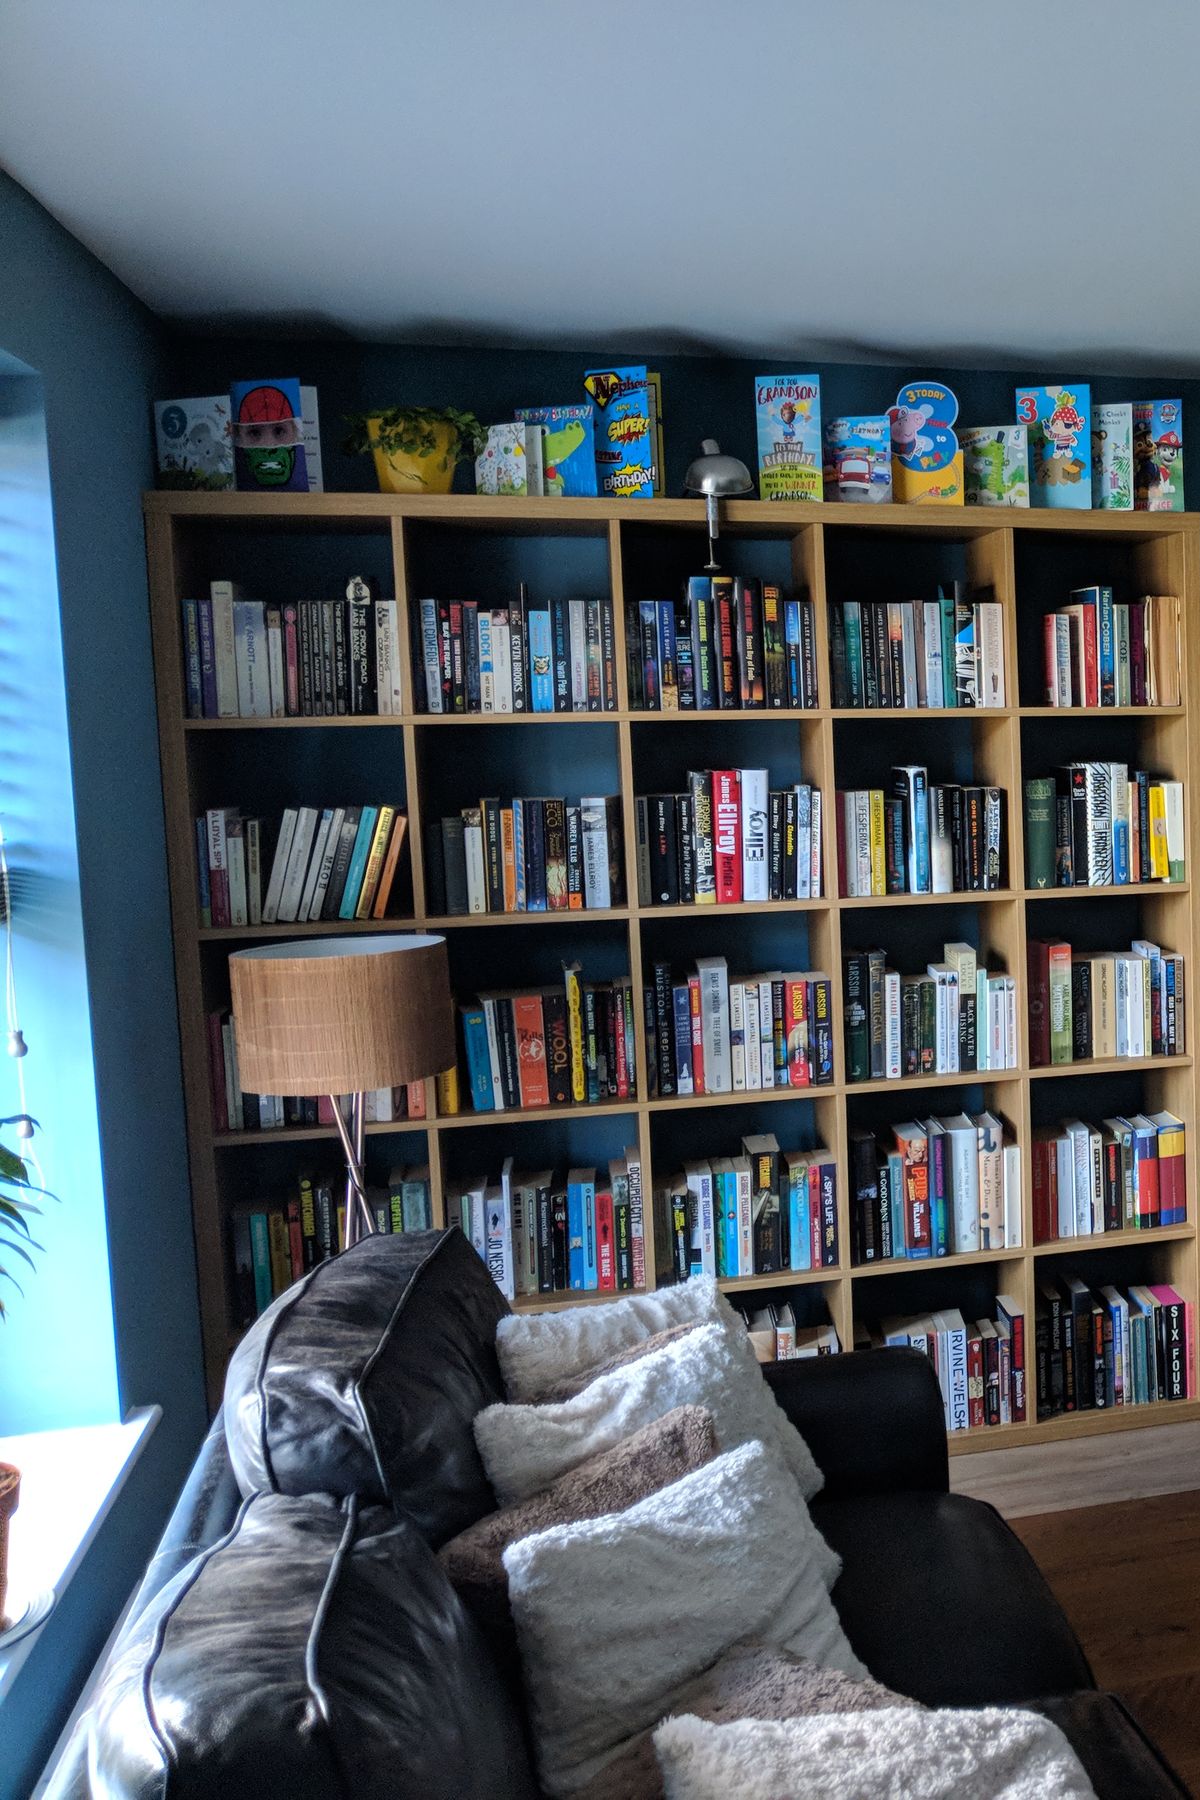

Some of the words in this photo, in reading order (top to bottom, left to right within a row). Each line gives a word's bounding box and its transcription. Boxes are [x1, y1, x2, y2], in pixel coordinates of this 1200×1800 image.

[593, 375, 648, 399] Nephew
[758, 386, 818, 405] GRANDSON
[906, 390, 916, 403] 3
[915, 389, 945, 401] TODAY
[1018, 397, 1038, 424] 3
[608, 418, 650, 442] SUPER!
[936, 434, 947, 443] to
[603, 466, 656, 492] BIRTHDAY!
[422, 605, 434, 626] COLD
[1102, 590, 1111, 620] Harlan
[359, 629, 367, 656] CROW
[424, 628, 438, 667] COMFORT
[479, 620, 491, 656] BLOCK
[512, 635, 521, 660] KEVIN
[1102, 621, 1110, 655] COBEN
[360, 658, 368, 684] ROAD
[443, 652, 451, 679] REAPER
[513, 662, 523, 692] BROOKS
[721, 776, 731, 803] James
[1092, 773, 1108, 818] JONATHAN
[546, 803, 558, 827] ECO
[569, 816, 577, 843] WARREN
[715, 804, 737, 855] Ellroy
[859, 808, 868, 858] FESPERMAN
[570, 846, 578, 863] ELLIS
[1093, 831, 1108, 871] FRANZEN
[320, 855, 334, 880] MAO
[588, 863, 596, 890] ELLROY
[722, 856, 733, 886] Perfidia
[711, 972, 719, 988] DENIS
[848, 960, 859, 997] LARSSON
[655, 969, 665, 1016] HUSTON
[792, 985, 803, 1019] LARSSON
[816, 984, 827, 1018] LARSSON
[1053, 984, 1063, 1033] MATTERHORN
[712, 1017, 720, 1029] TREE
[552, 1021, 568, 1073] WOOL
[967, 1027, 975, 1057] WATER
[630, 1167, 641, 1205] OCCUPIED
[824, 1181, 833, 1206] SPY'S
[880, 1179, 889, 1198] GOOD
[912, 1166, 928, 1200] PULP
[984, 1179, 990, 1188] &
[630, 1207, 642, 1225] CITY
[825, 1207, 834, 1225] LIFE
[601, 1243, 610, 1258] THE
[632, 1236, 643, 1259] DAVID
[601, 1259, 610, 1277] RACE
[633, 1260, 645, 1284] PEACE
[1170, 1306, 1181, 1341] SIX
[952, 1329, 964, 1377] IRVINE
[1171, 1348, 1182, 1395] FOUR
[953, 1381, 966, 1431] WELSH
